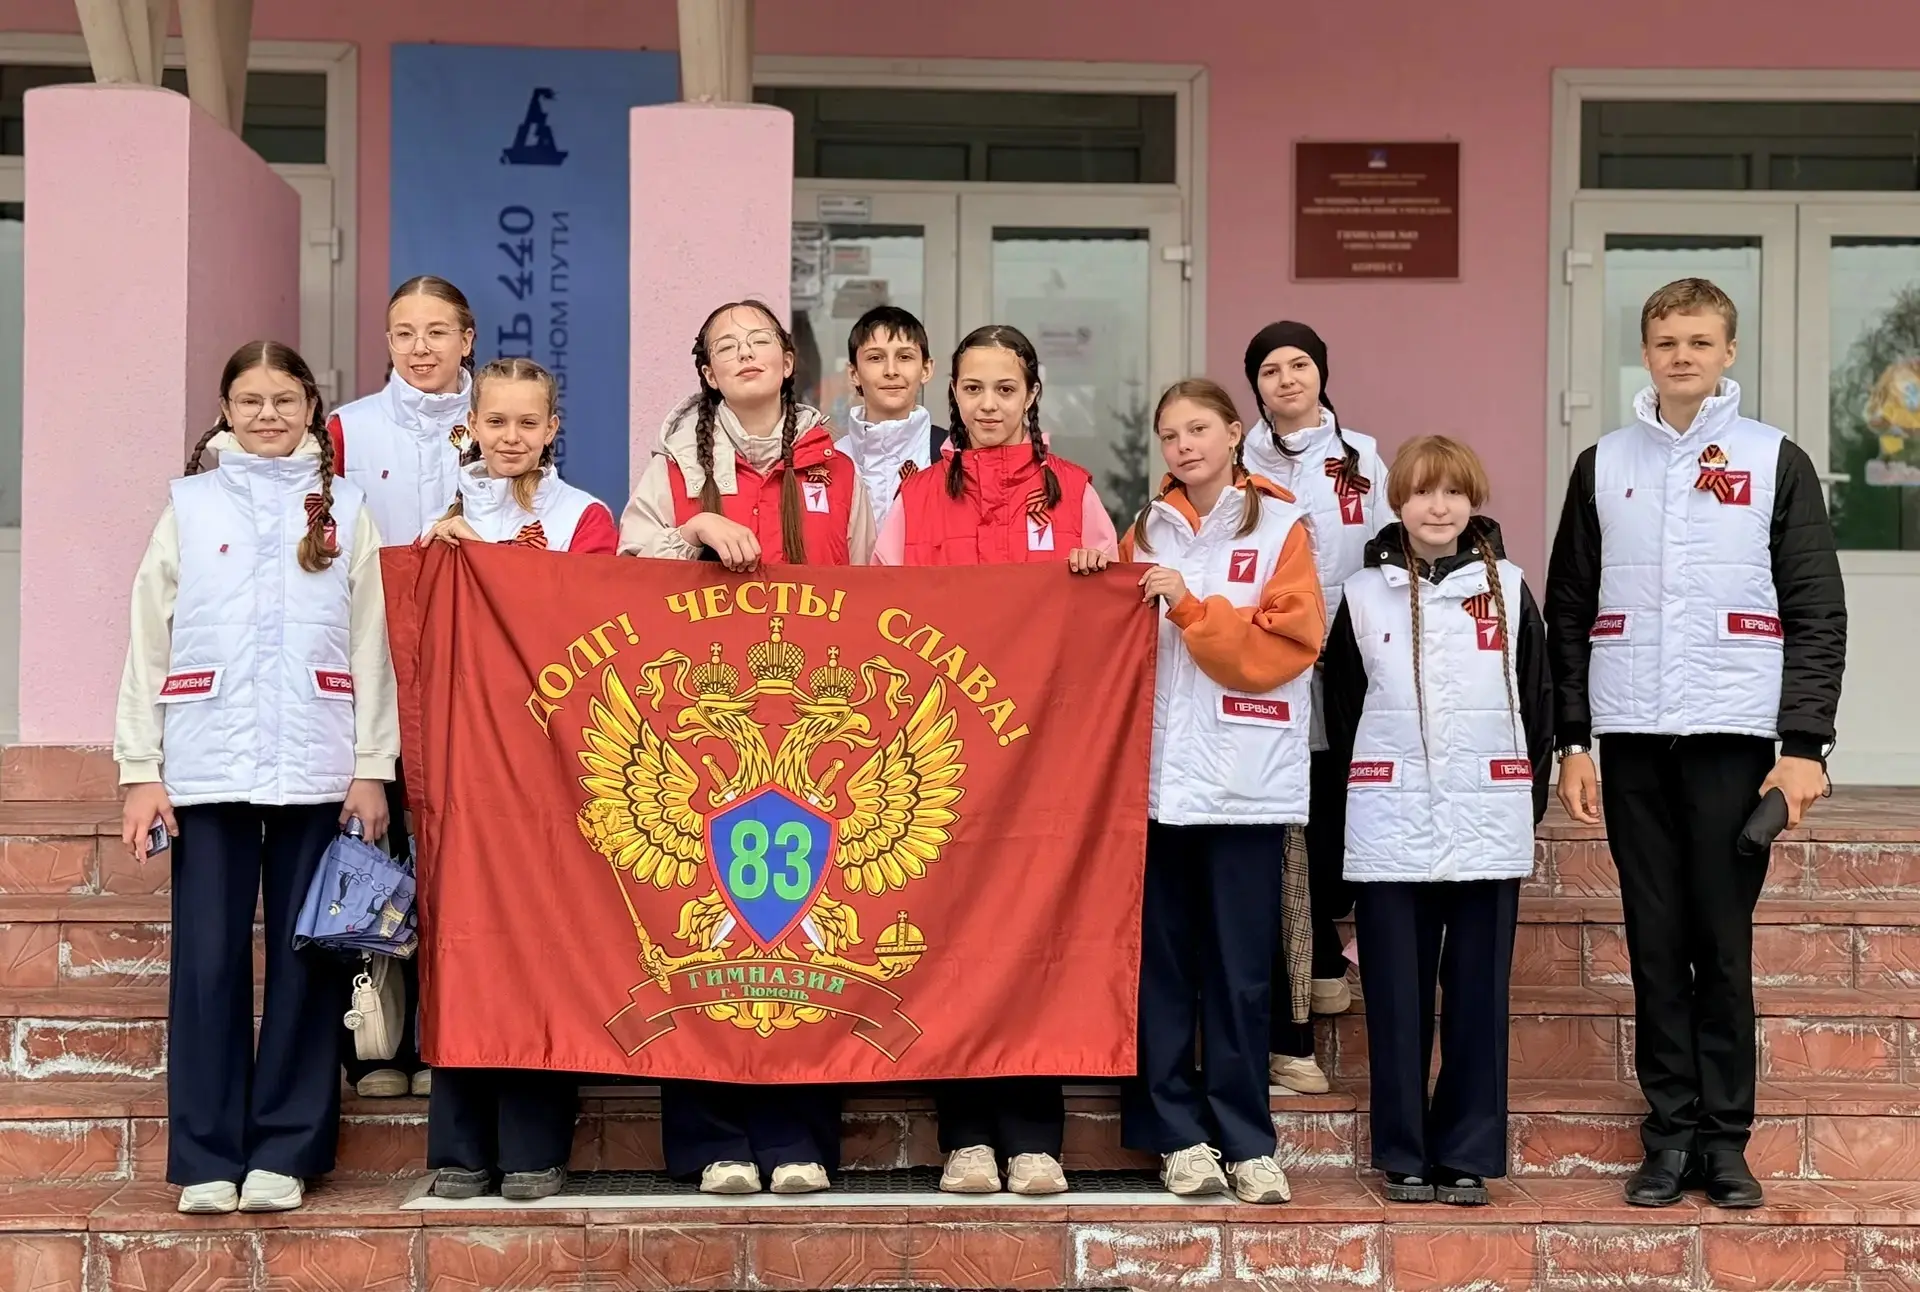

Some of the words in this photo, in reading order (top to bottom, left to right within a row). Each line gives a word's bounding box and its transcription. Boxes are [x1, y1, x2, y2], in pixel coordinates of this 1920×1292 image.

[497, 205, 534, 300] 440
[550, 211, 569, 291] ПУТИ
[1740, 618, 1777, 632] ПЕРВЫХ
[524, 611, 641, 739] ДОЛГ!
[664, 581, 847, 623] ЧЕСТЬ!
[877, 607, 1031, 747] СЛАВА!
[165, 676, 211, 692] ДВИЖЕНИЕ
[325, 676, 352, 689] ПЕРВЫ
[1234, 702, 1279, 716] ПЕРВЫХ
[729, 818, 812, 901] 83
[687, 966, 846, 994] ГИМНАЗИЯ
[741, 984, 810, 1001] Тюмень
